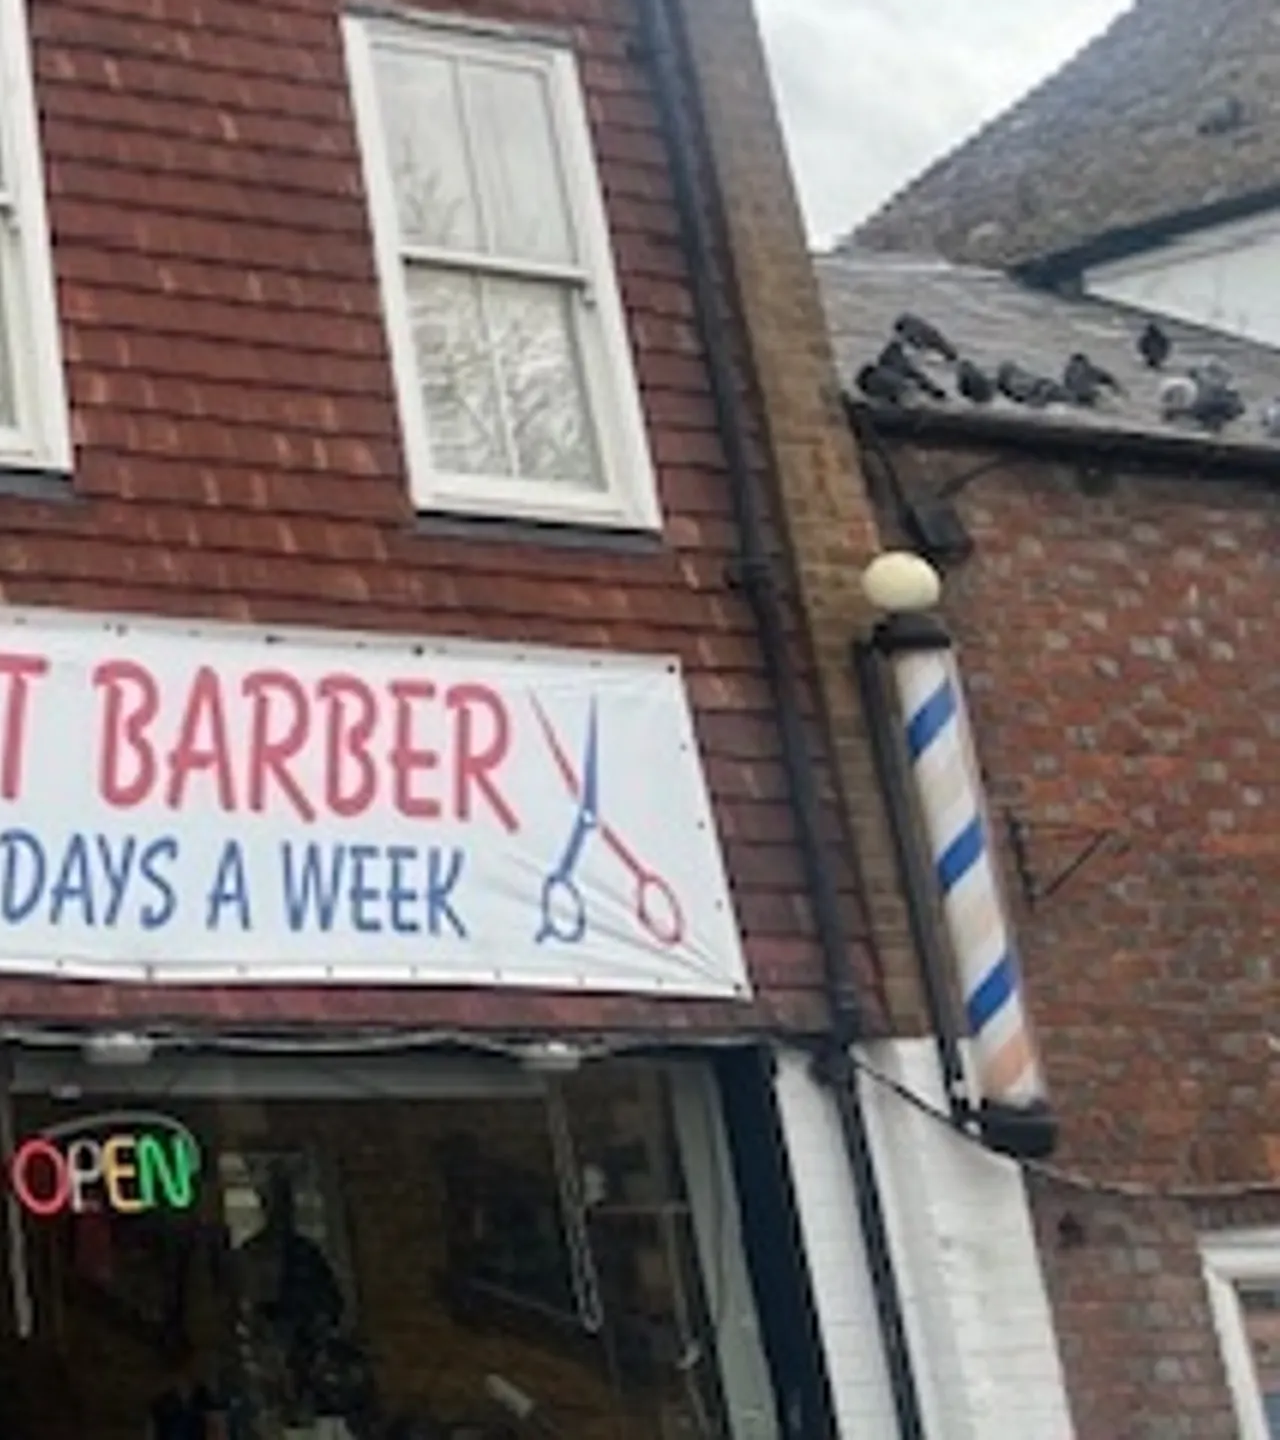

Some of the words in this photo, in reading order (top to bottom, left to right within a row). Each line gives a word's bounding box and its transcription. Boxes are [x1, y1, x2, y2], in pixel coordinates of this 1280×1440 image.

[92, 659, 519, 833] BARBER
[206, 840, 255, 930] A
[281, 843, 467, 940] WEEK
[11, 1133, 197, 1214] OPEN
